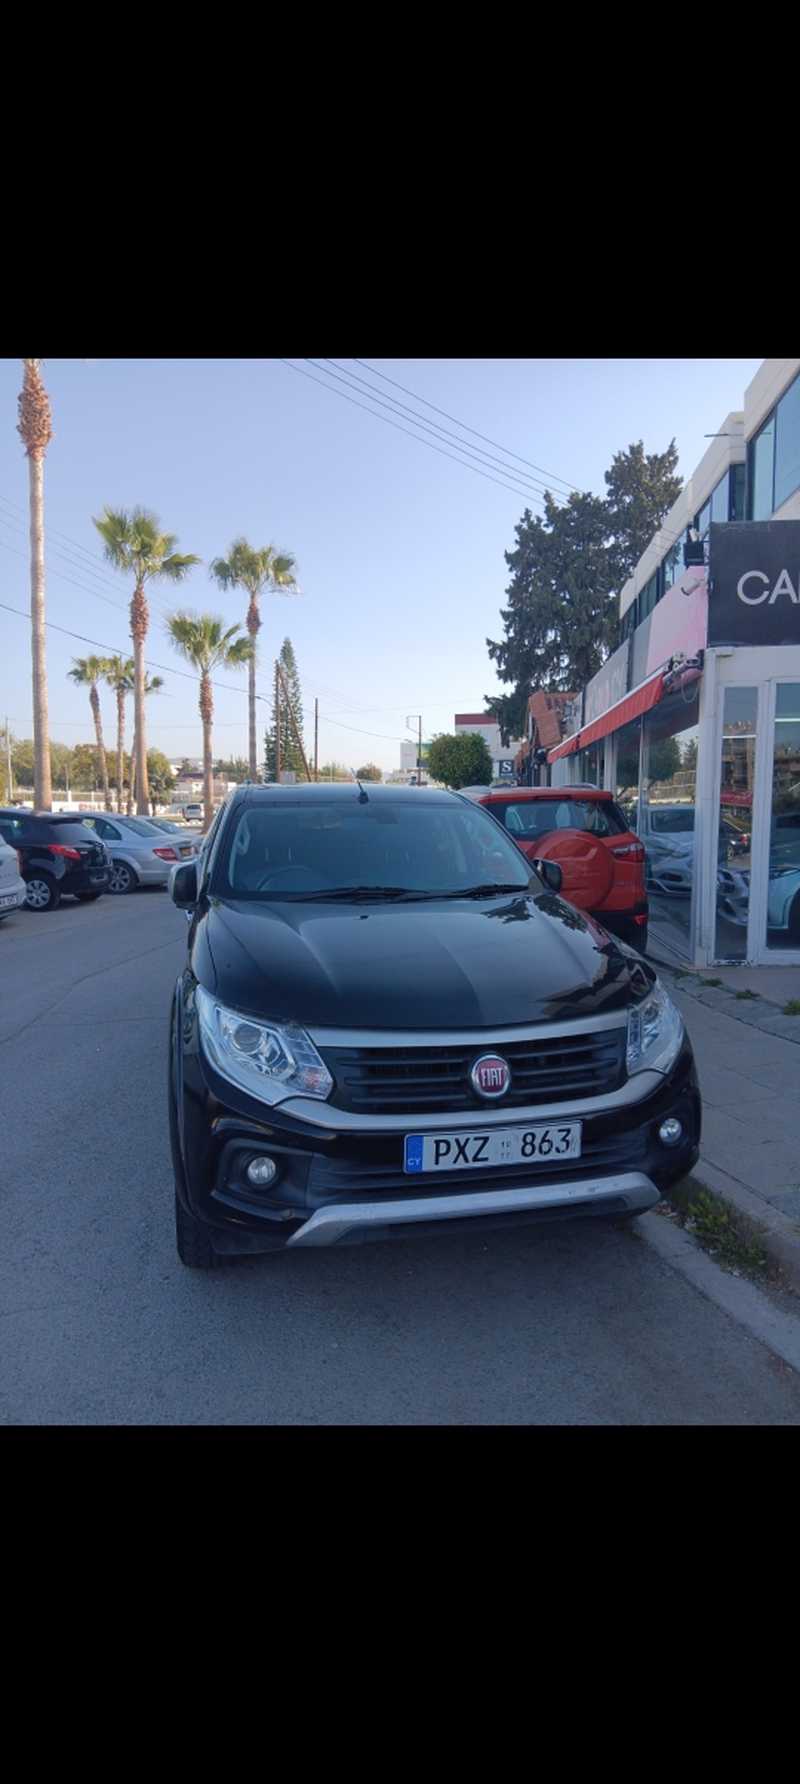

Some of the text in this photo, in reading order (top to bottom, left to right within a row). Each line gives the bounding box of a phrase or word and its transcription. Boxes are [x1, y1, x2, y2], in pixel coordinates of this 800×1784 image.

[737, 569, 800, 605] CA
[501, 761, 512, 772] S
[480, 1066, 503, 1087] FIAT
[433, 1128, 572, 1165] PXZ 863
[407, 1157, 421, 1166] CY
